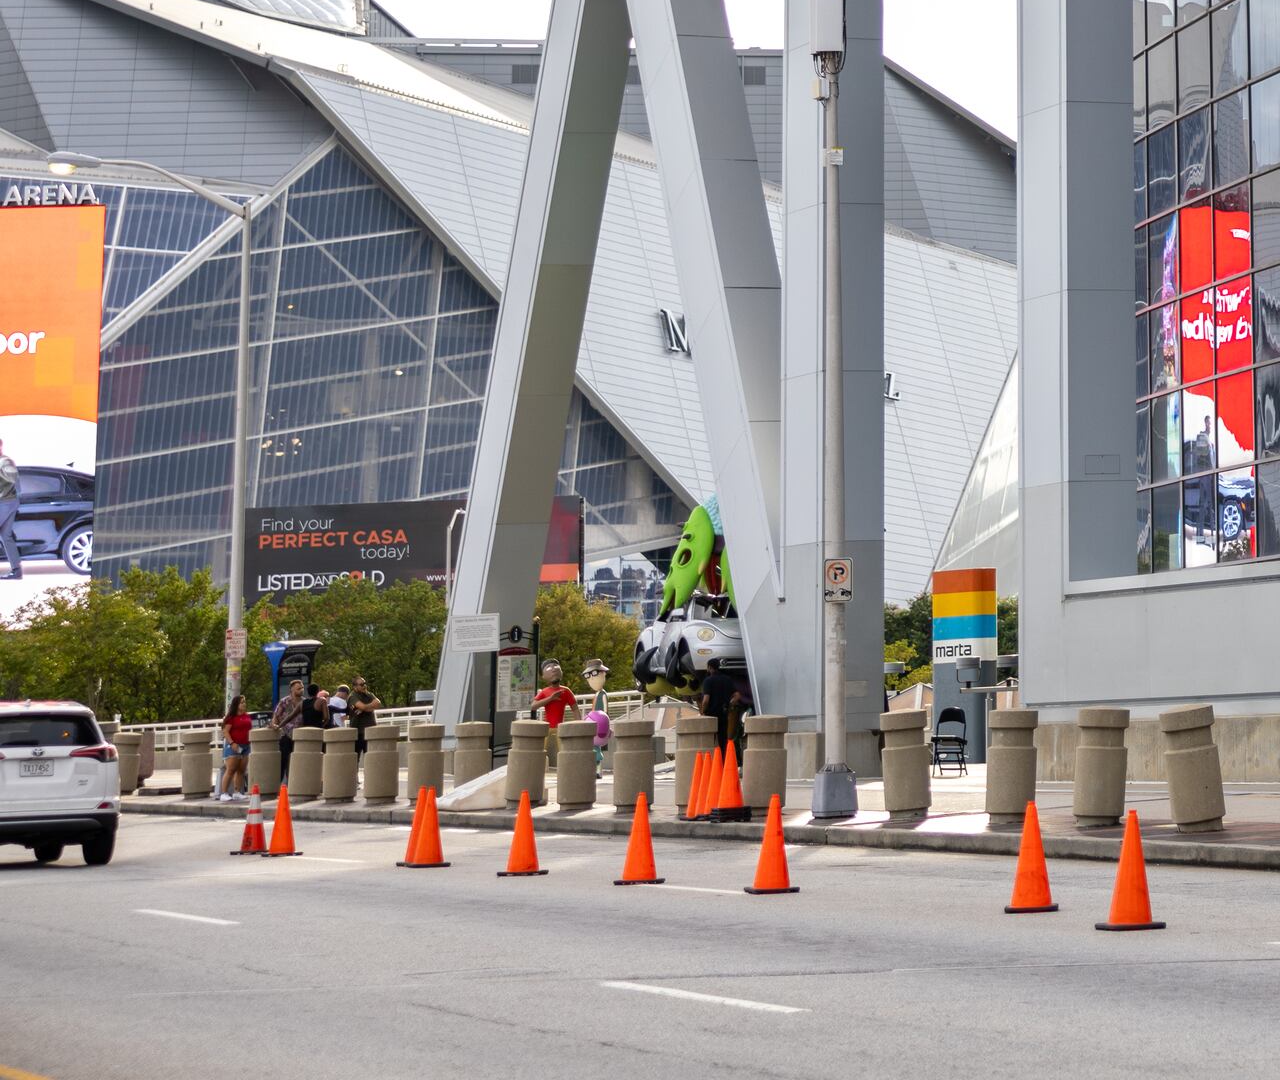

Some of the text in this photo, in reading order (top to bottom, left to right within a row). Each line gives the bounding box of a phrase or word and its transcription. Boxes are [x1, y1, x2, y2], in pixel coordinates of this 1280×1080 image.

[261, 518, 335, 534] Find your
[258, 529, 408, 551] PERFECT CASA
[361, 544, 411, 561] today!
[936, 643, 972, 658] marta
